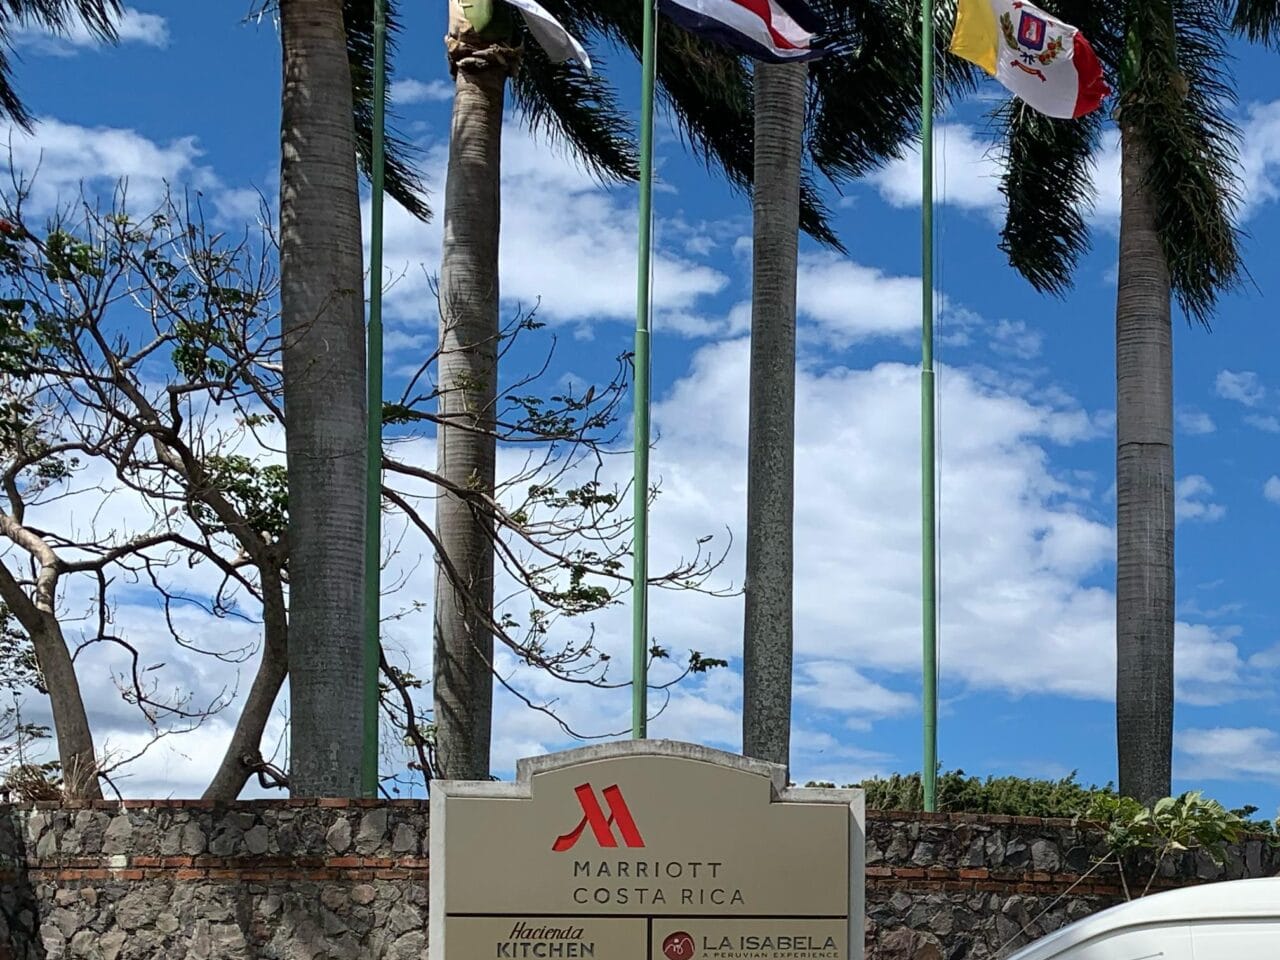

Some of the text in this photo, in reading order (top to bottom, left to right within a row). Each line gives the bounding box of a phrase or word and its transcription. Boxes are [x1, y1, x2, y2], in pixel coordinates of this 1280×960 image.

[573, 861, 723, 878] MARRIOTT
[573, 887, 745, 905] COSTA RICA
[509, 921, 585, 940] Hacienda
[496, 942, 595, 958] KITCHEN
[703, 936, 838, 950] LA ISABELA
